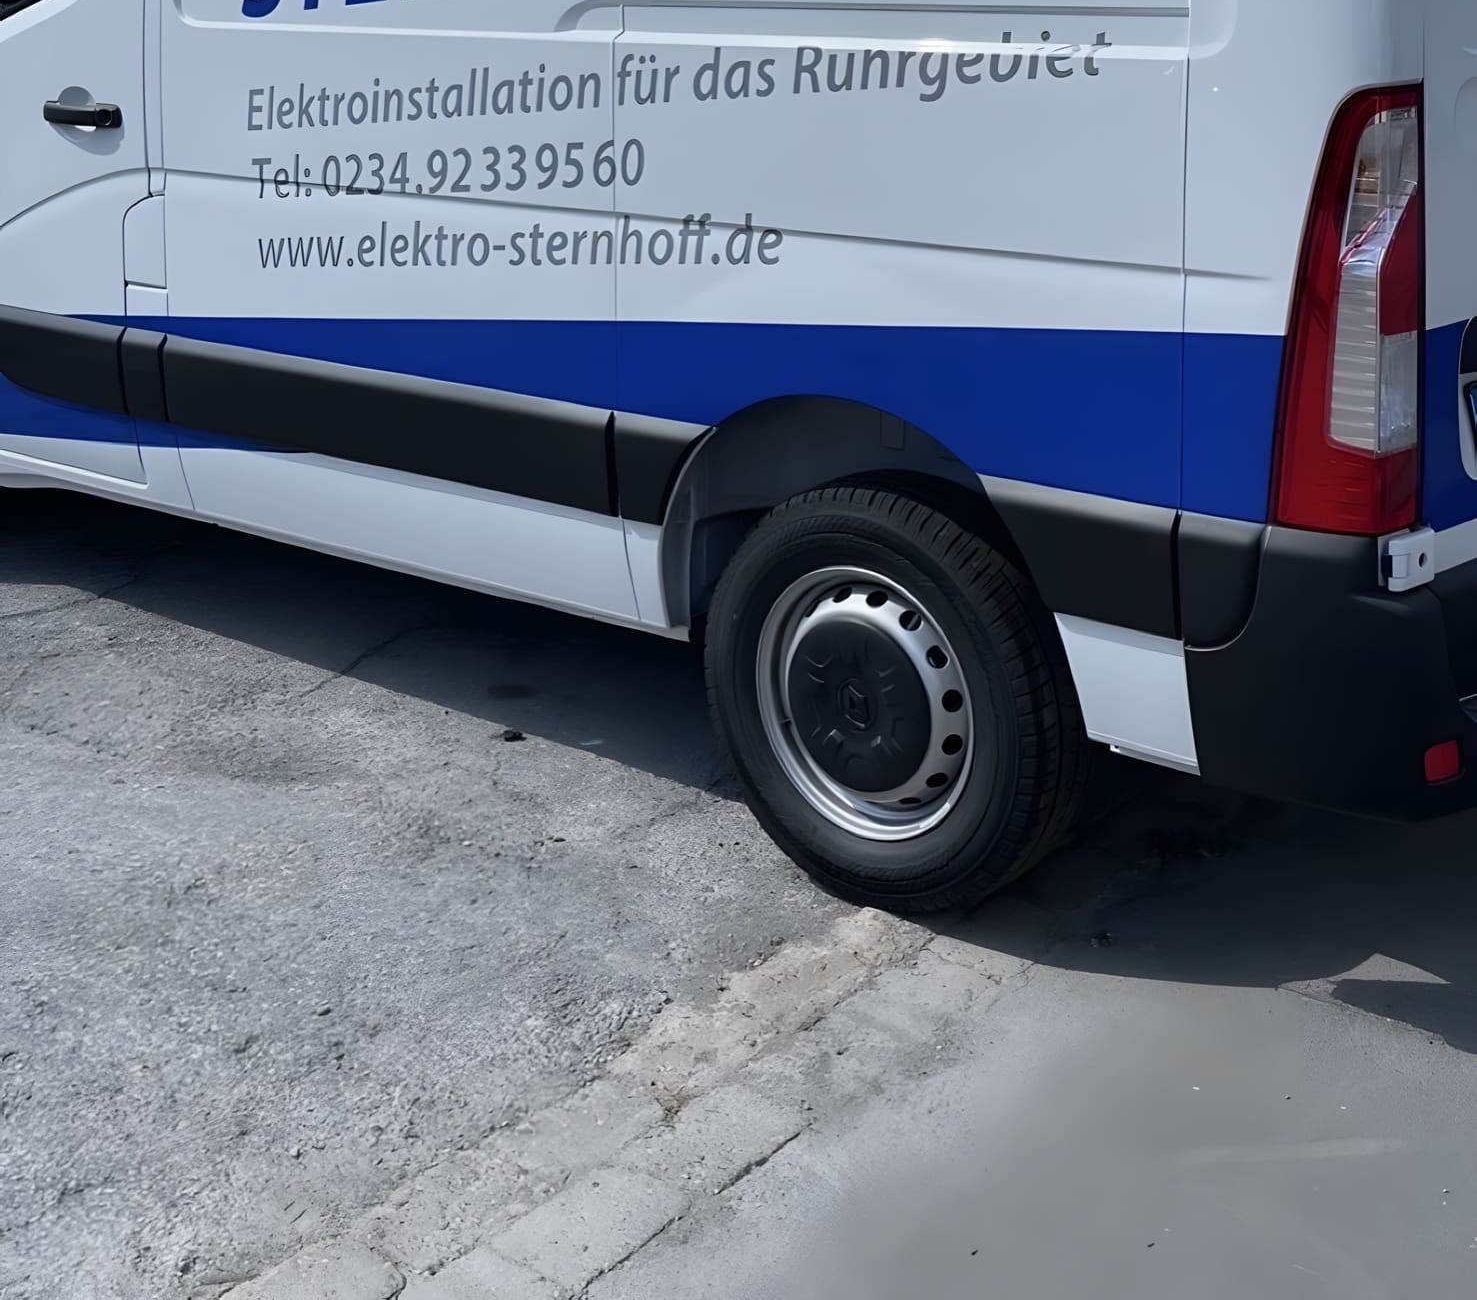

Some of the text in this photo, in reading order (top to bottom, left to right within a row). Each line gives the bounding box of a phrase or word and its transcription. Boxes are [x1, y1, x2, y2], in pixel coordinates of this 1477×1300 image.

[247, 31, 1112, 132] Elektroinstallation für das Ruhrgebiet
[252, 154, 313, 199] Tel:
[258, 213, 783, 269] www.elektro-sternhoff.de
